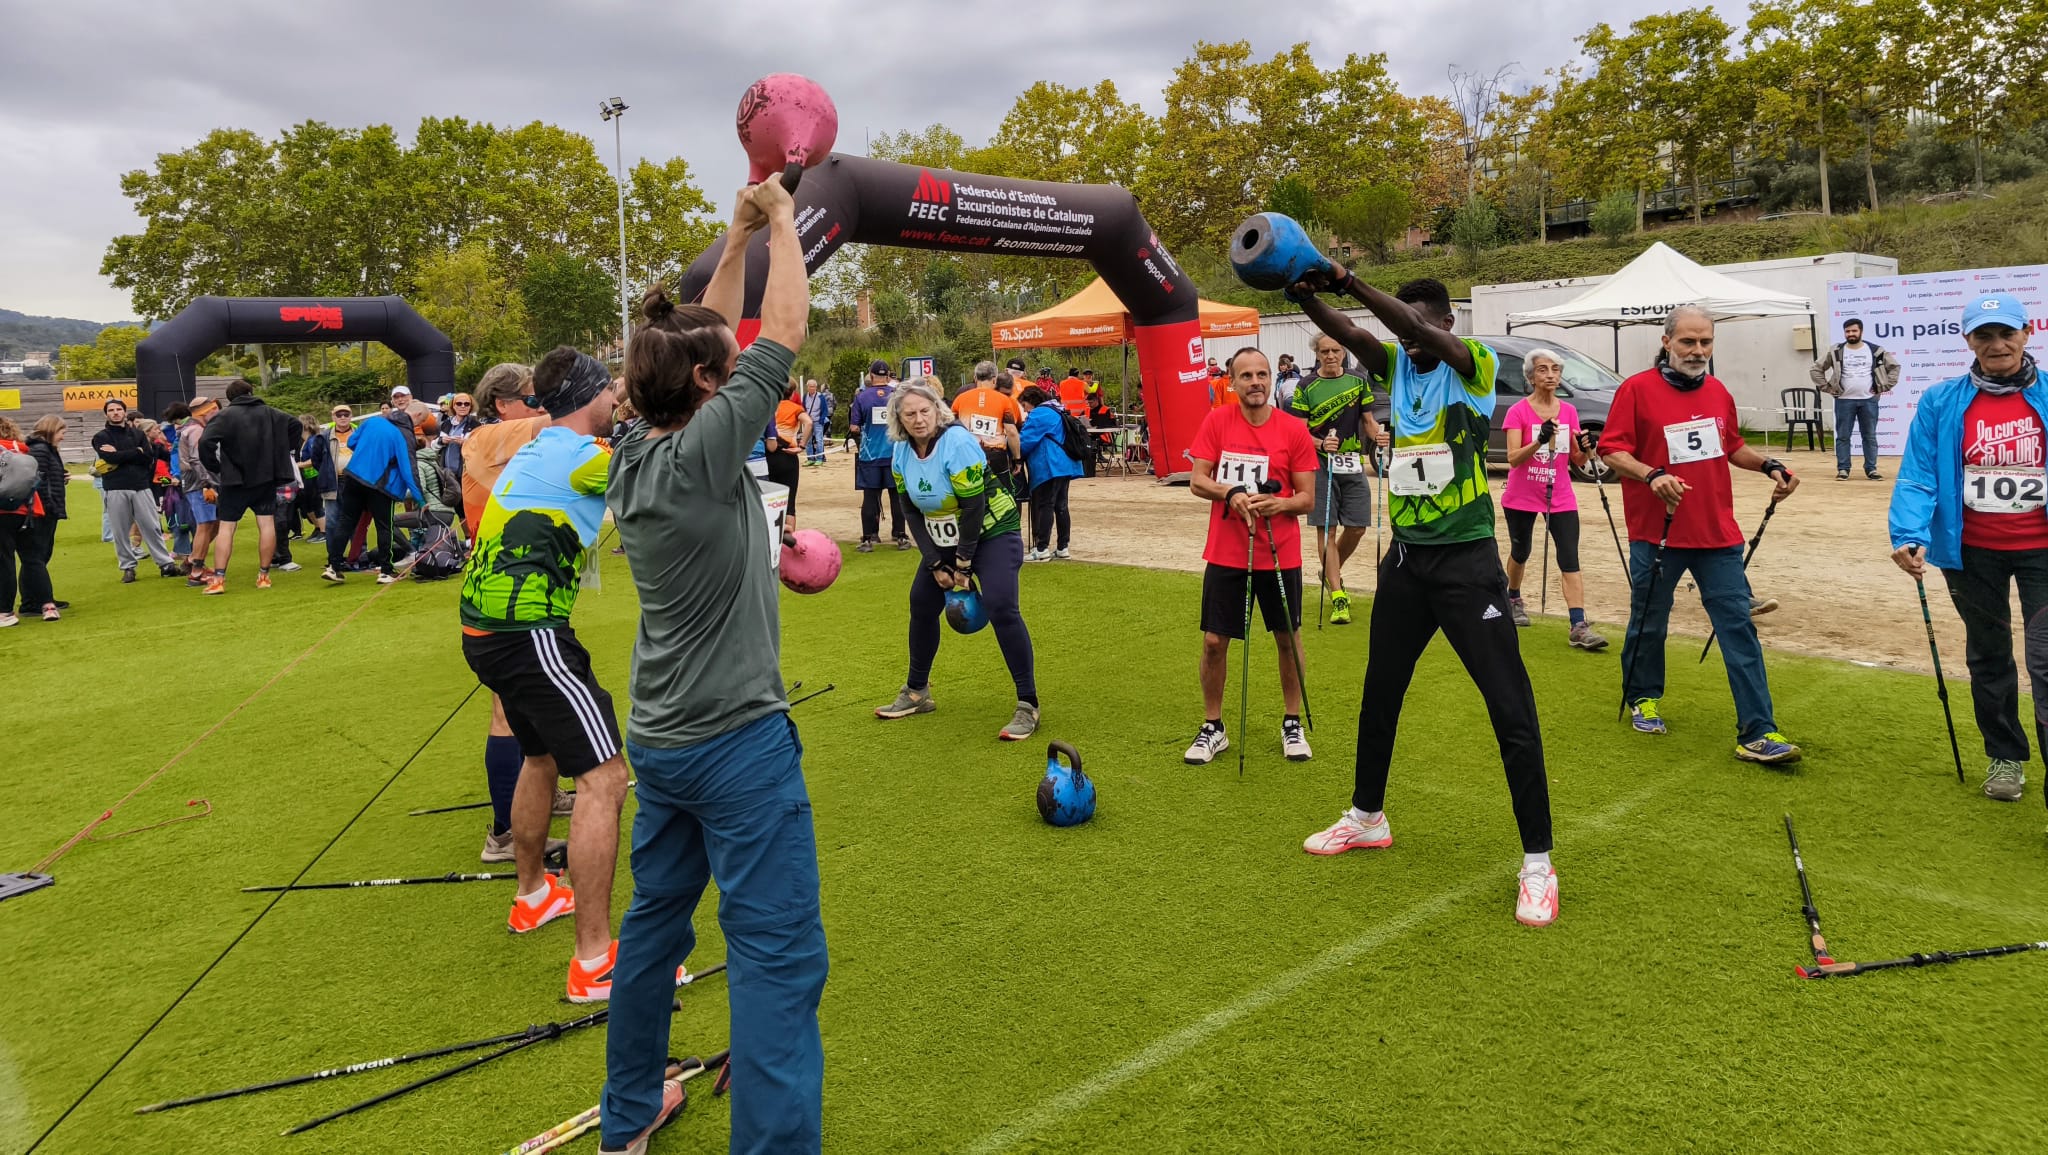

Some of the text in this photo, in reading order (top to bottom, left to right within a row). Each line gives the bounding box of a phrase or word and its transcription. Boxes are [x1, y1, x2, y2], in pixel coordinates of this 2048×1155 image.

[952, 183, 1057, 206] Federació d'Entitats
[908, 202, 950, 221] FEEC
[957, 198, 1094, 224] Excursionistes de Catalunya
[956, 215, 992, 227] Federació
[992, 219, 1022, 230] Catalana
[1023, 223, 1062, 234] d'Alpinisme
[1065, 227, 1092, 236] Escalada
[901, 228, 992, 246] www.feec.cat
[995, 238, 1084, 254] #sommuntanya
[1145, 258, 1174, 294] esportcat
[1621, 302, 1697, 316] ESPOR
[1000, 325, 1044, 342] 9h.Sports
[1875, 323, 1904, 338] Un
[923, 361, 932, 375] 5
[65, 389, 114, 401] MARXA
[975, 419, 990, 431] 91
[1688, 431, 1702, 450] 5
[1334, 456, 1354, 468] 95
[1412, 458, 1425, 481] 1
[1222, 462, 1261, 482] 111
[1971, 476, 2044, 501] 102
[927, 522, 957, 538] 110
